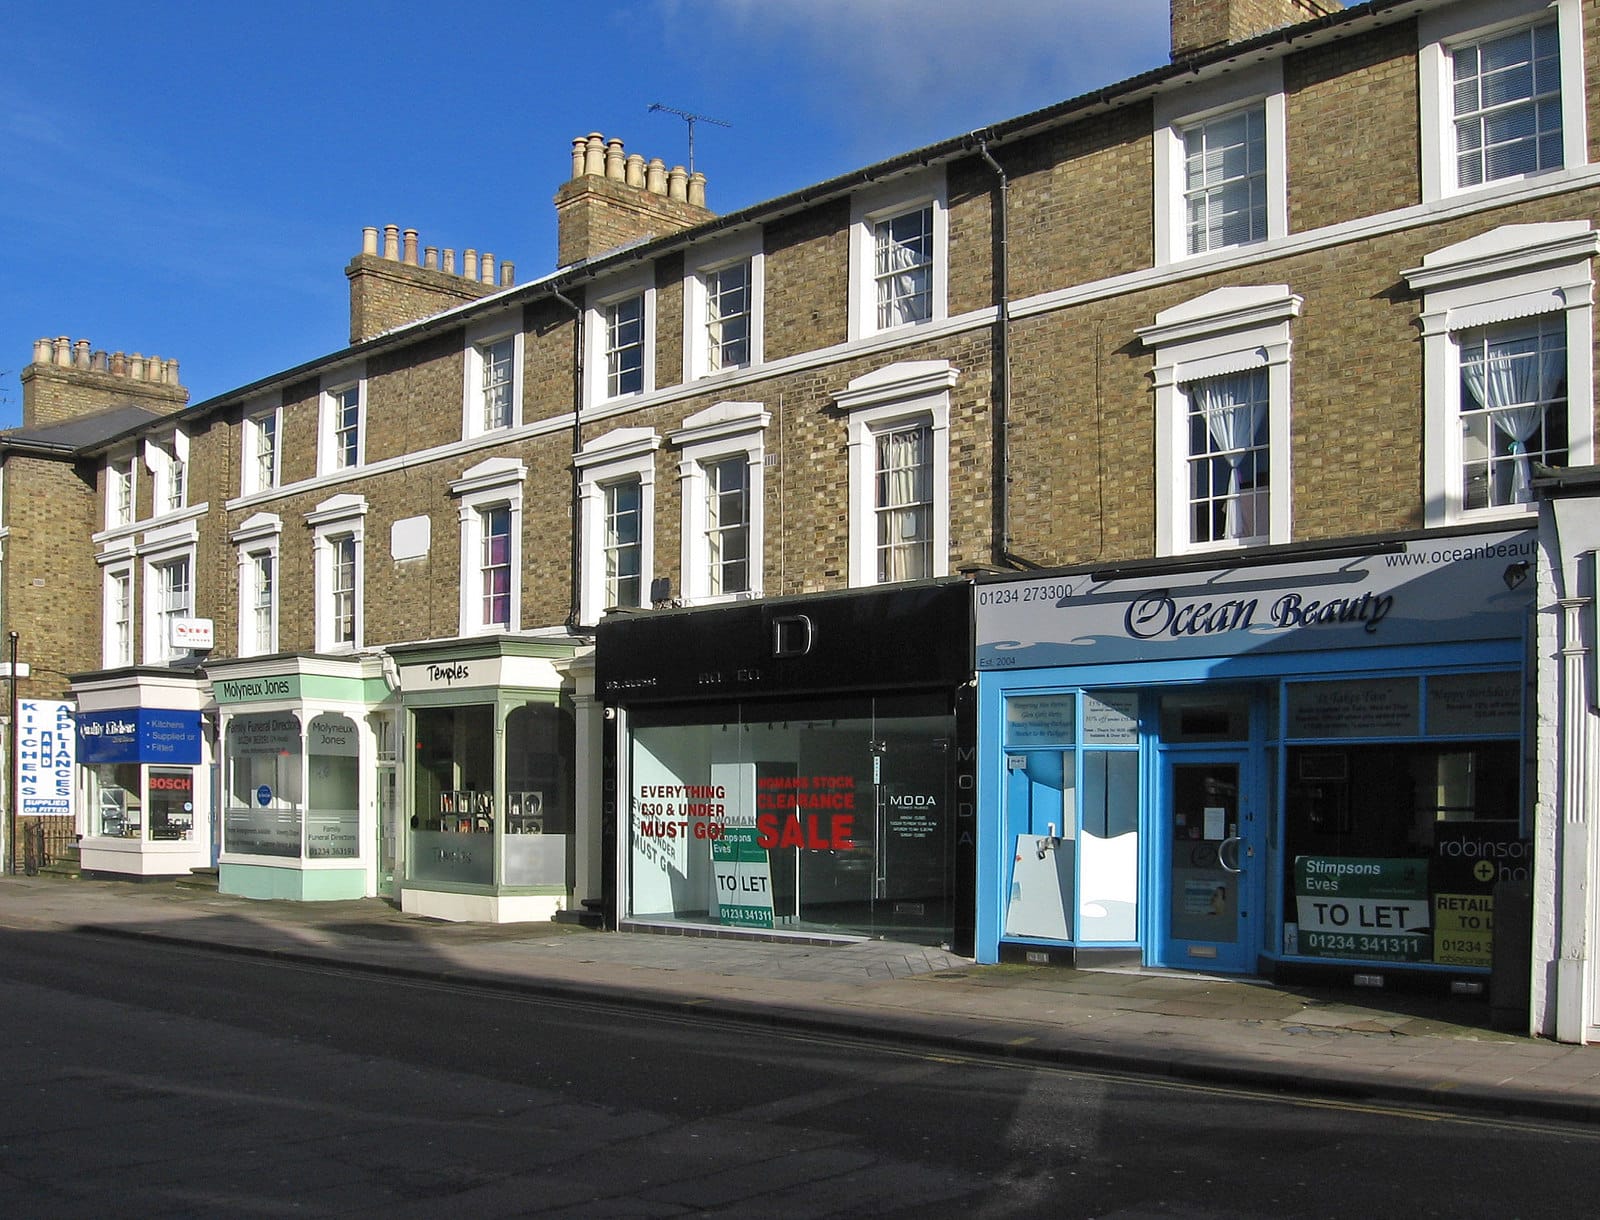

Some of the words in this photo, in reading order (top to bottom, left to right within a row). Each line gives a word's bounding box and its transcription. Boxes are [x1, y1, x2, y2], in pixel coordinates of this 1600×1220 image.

[979, 589, 1018, 605] 01234
[1023, 584, 1073, 602] 273300
[1124, 588, 1259, 640] Ocean
[1270, 591, 1393, 633] Beauty
[996, 656, 1016, 667] 2004
[427, 660, 469, 686] Temples
[223, 682, 262, 700] Molyneux
[264, 680, 289, 695] Jones
[151, 720, 184, 728] Kitchens
[312, 722, 353, 734] Molyneux
[152, 732, 186, 741] Supplied
[320, 734, 346, 745] Jones
[21, 702, 38, 796] KITCHENS
[55, 704, 72, 797] APPLIANCES
[150, 777, 191, 790] BOSCH
[812, 775, 855, 789] STOCK
[640, 785, 725, 799] EVERYTHING
[757, 793, 856, 810] CLEARANCE
[890, 795, 937, 806] MODA
[640, 803, 663, 816] £30
[665, 803, 675, 816] &
[678, 804, 725, 817] UNDER
[640, 821, 688, 839] MUST
[693, 822, 726, 840] GO!
[755, 813, 856, 850] SALE
[713, 843, 731, 854] Eves
[1306, 860, 1381, 875] Stimpsons
[717, 874, 737, 891] TO
[741, 876, 768, 893] LET
[1306, 877, 1339, 891] Eves
[1438, 897, 1494, 912] RETAIL
[720, 908, 744, 920] 01234
[744, 908, 772, 921] 341311
[1313, 903, 1349, 926] TO
[1359, 905, 1410, 929] LET
[1458, 915, 1481, 929] TO
[1309, 934, 1354, 950] 01234
[1360, 937, 1418, 953] 341311
[1442, 939, 1481, 953] 01234
